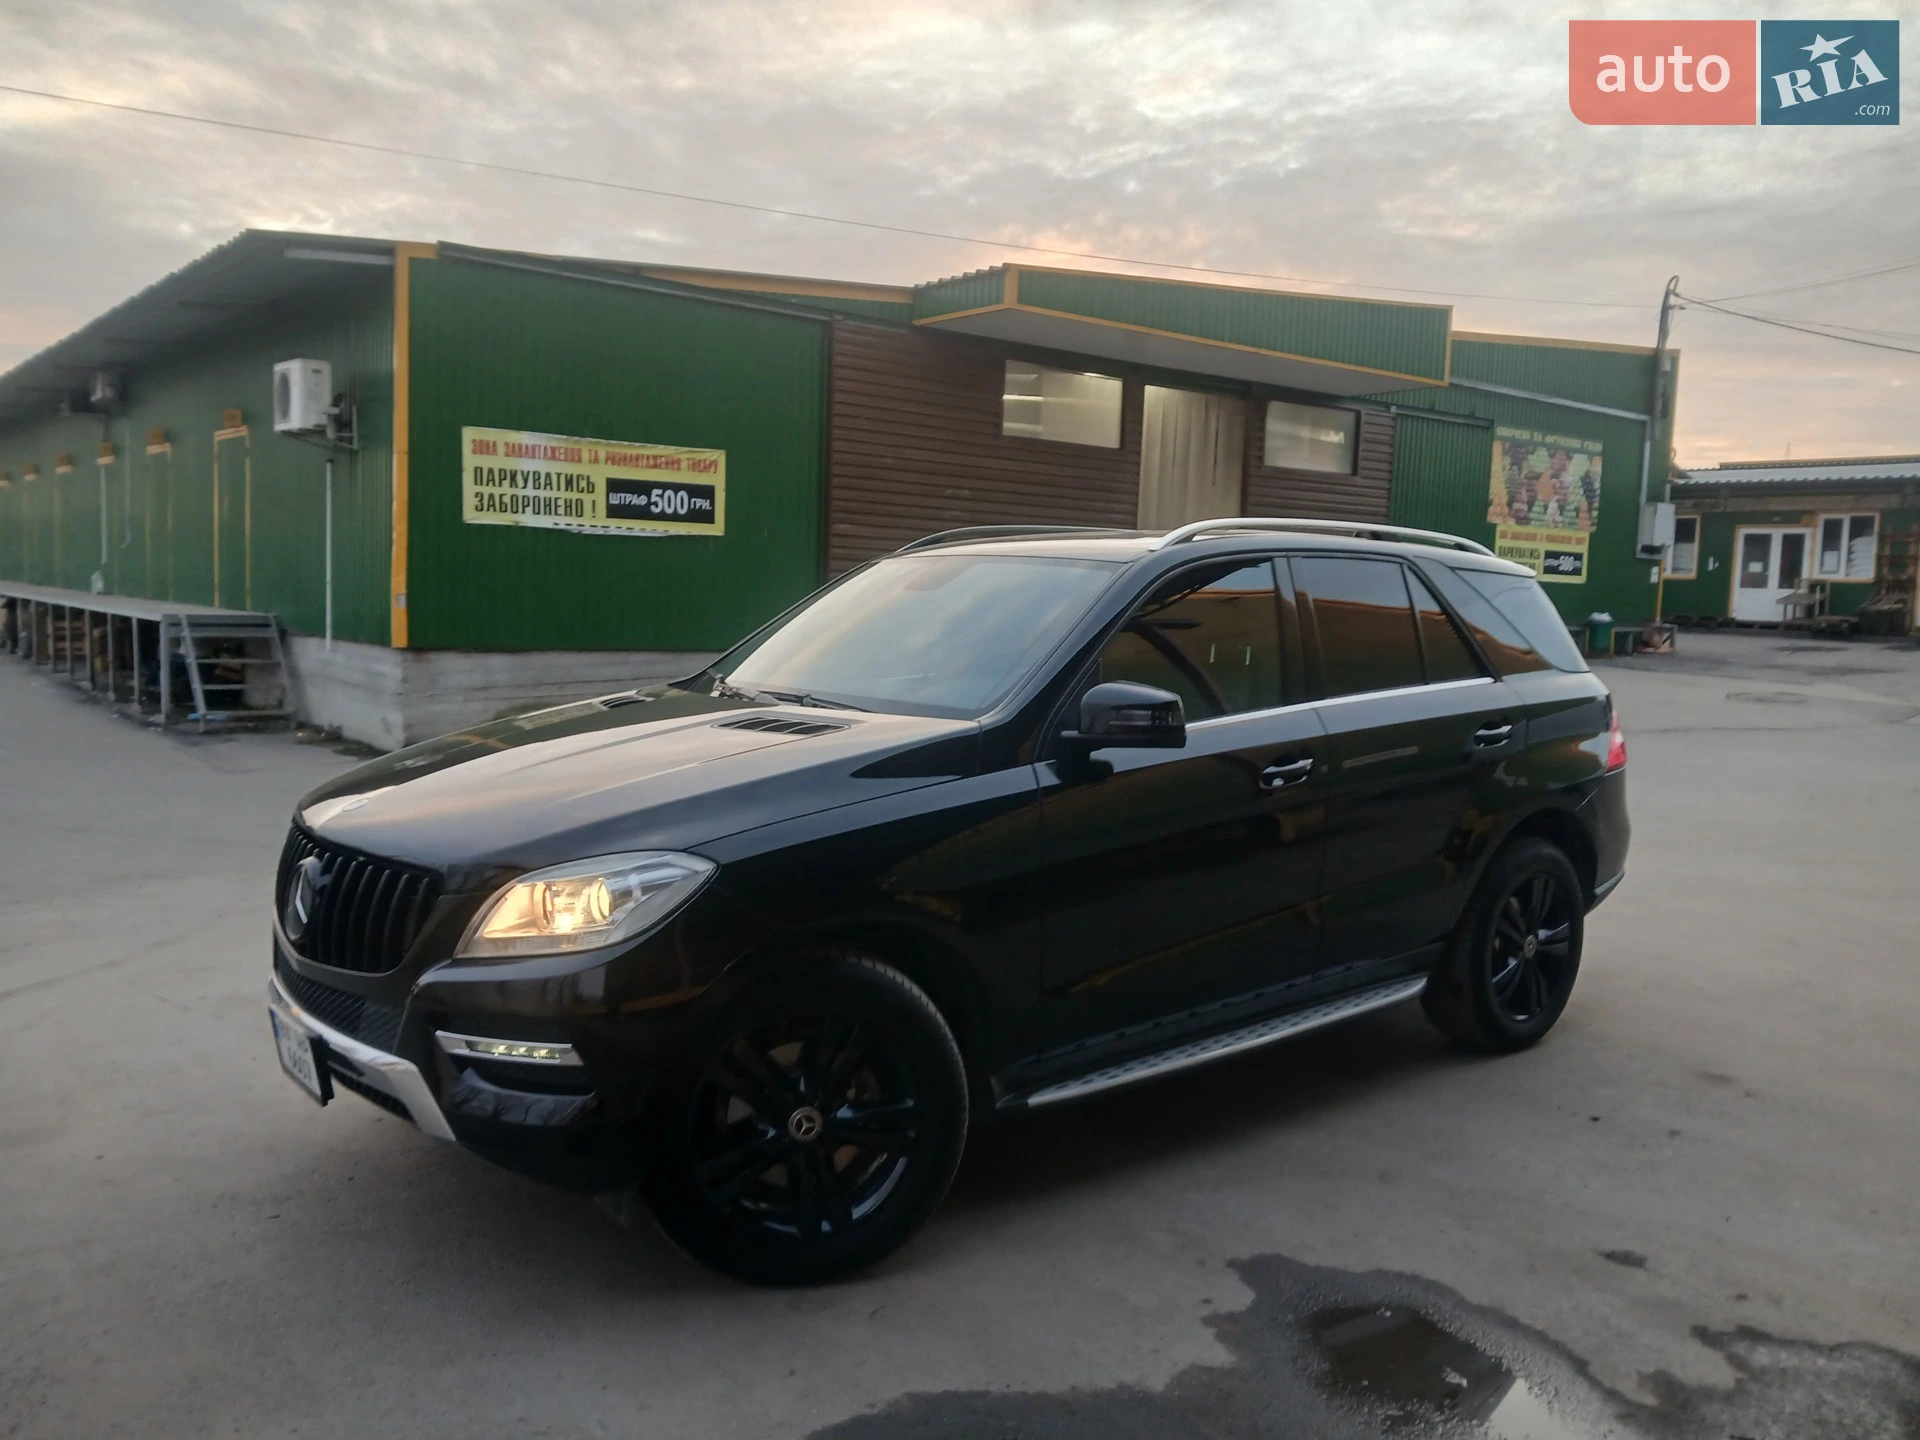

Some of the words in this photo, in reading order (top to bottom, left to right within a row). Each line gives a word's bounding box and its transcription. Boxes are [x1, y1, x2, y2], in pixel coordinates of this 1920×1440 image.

[588, 448, 600, 464] ТА
[473, 466, 596, 494] ПАРКУВАТИСЬ
[474, 491, 584, 518] ЗАБОРОНЕНО
[608, 492, 648, 506] ШТРАФ
[649, 488, 689, 516] 500
[690, 497, 713, 511] ГРН.
